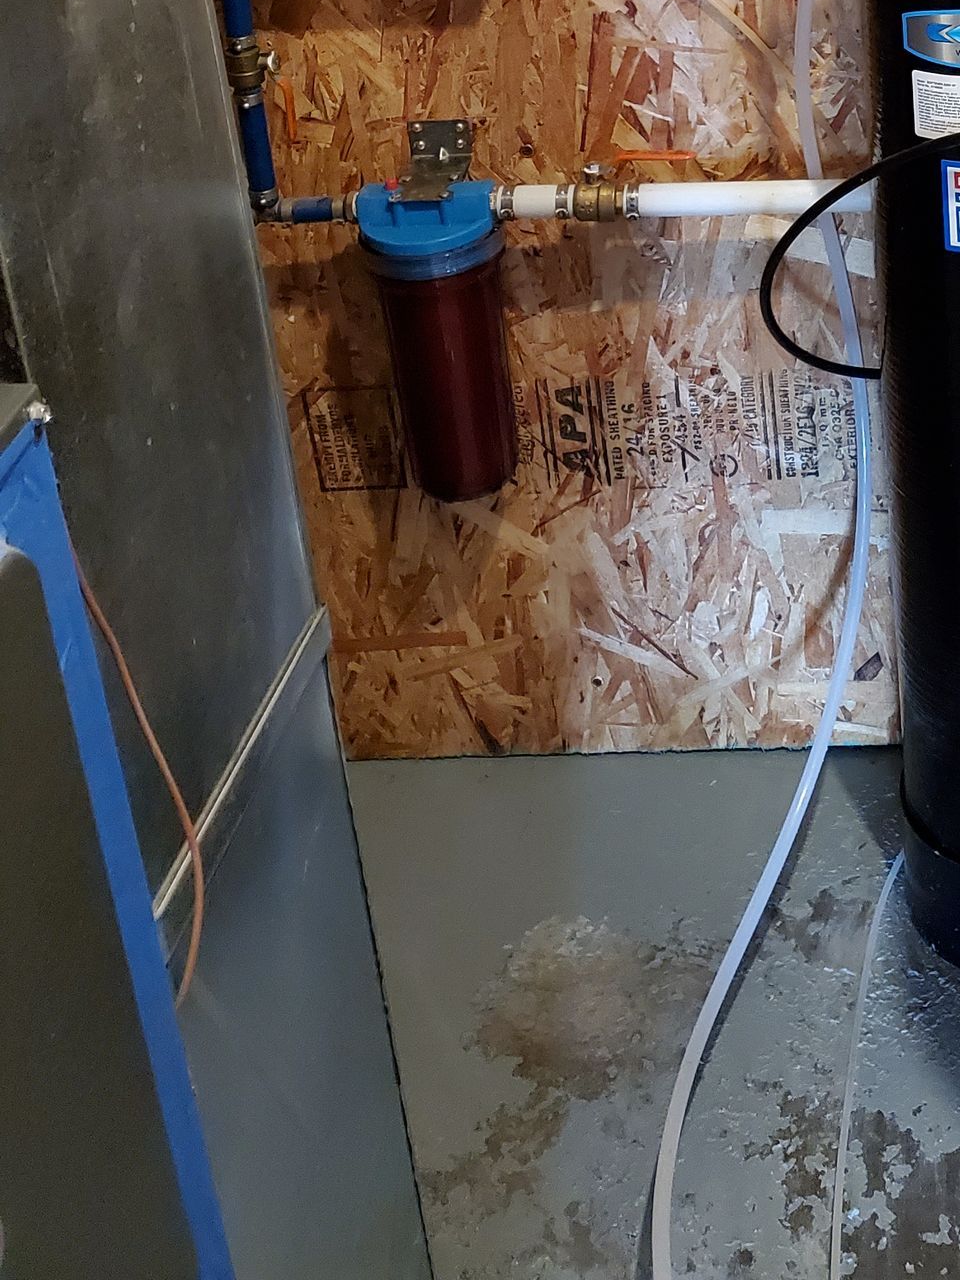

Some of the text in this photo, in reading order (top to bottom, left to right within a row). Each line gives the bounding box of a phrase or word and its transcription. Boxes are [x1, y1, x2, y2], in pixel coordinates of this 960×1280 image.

[741, 375, 758, 419] CATEGORY
[315, 414, 330, 442] FROM
[554, 385, 592, 478] APA
[656, 404, 673, 463] EXPOSURE
